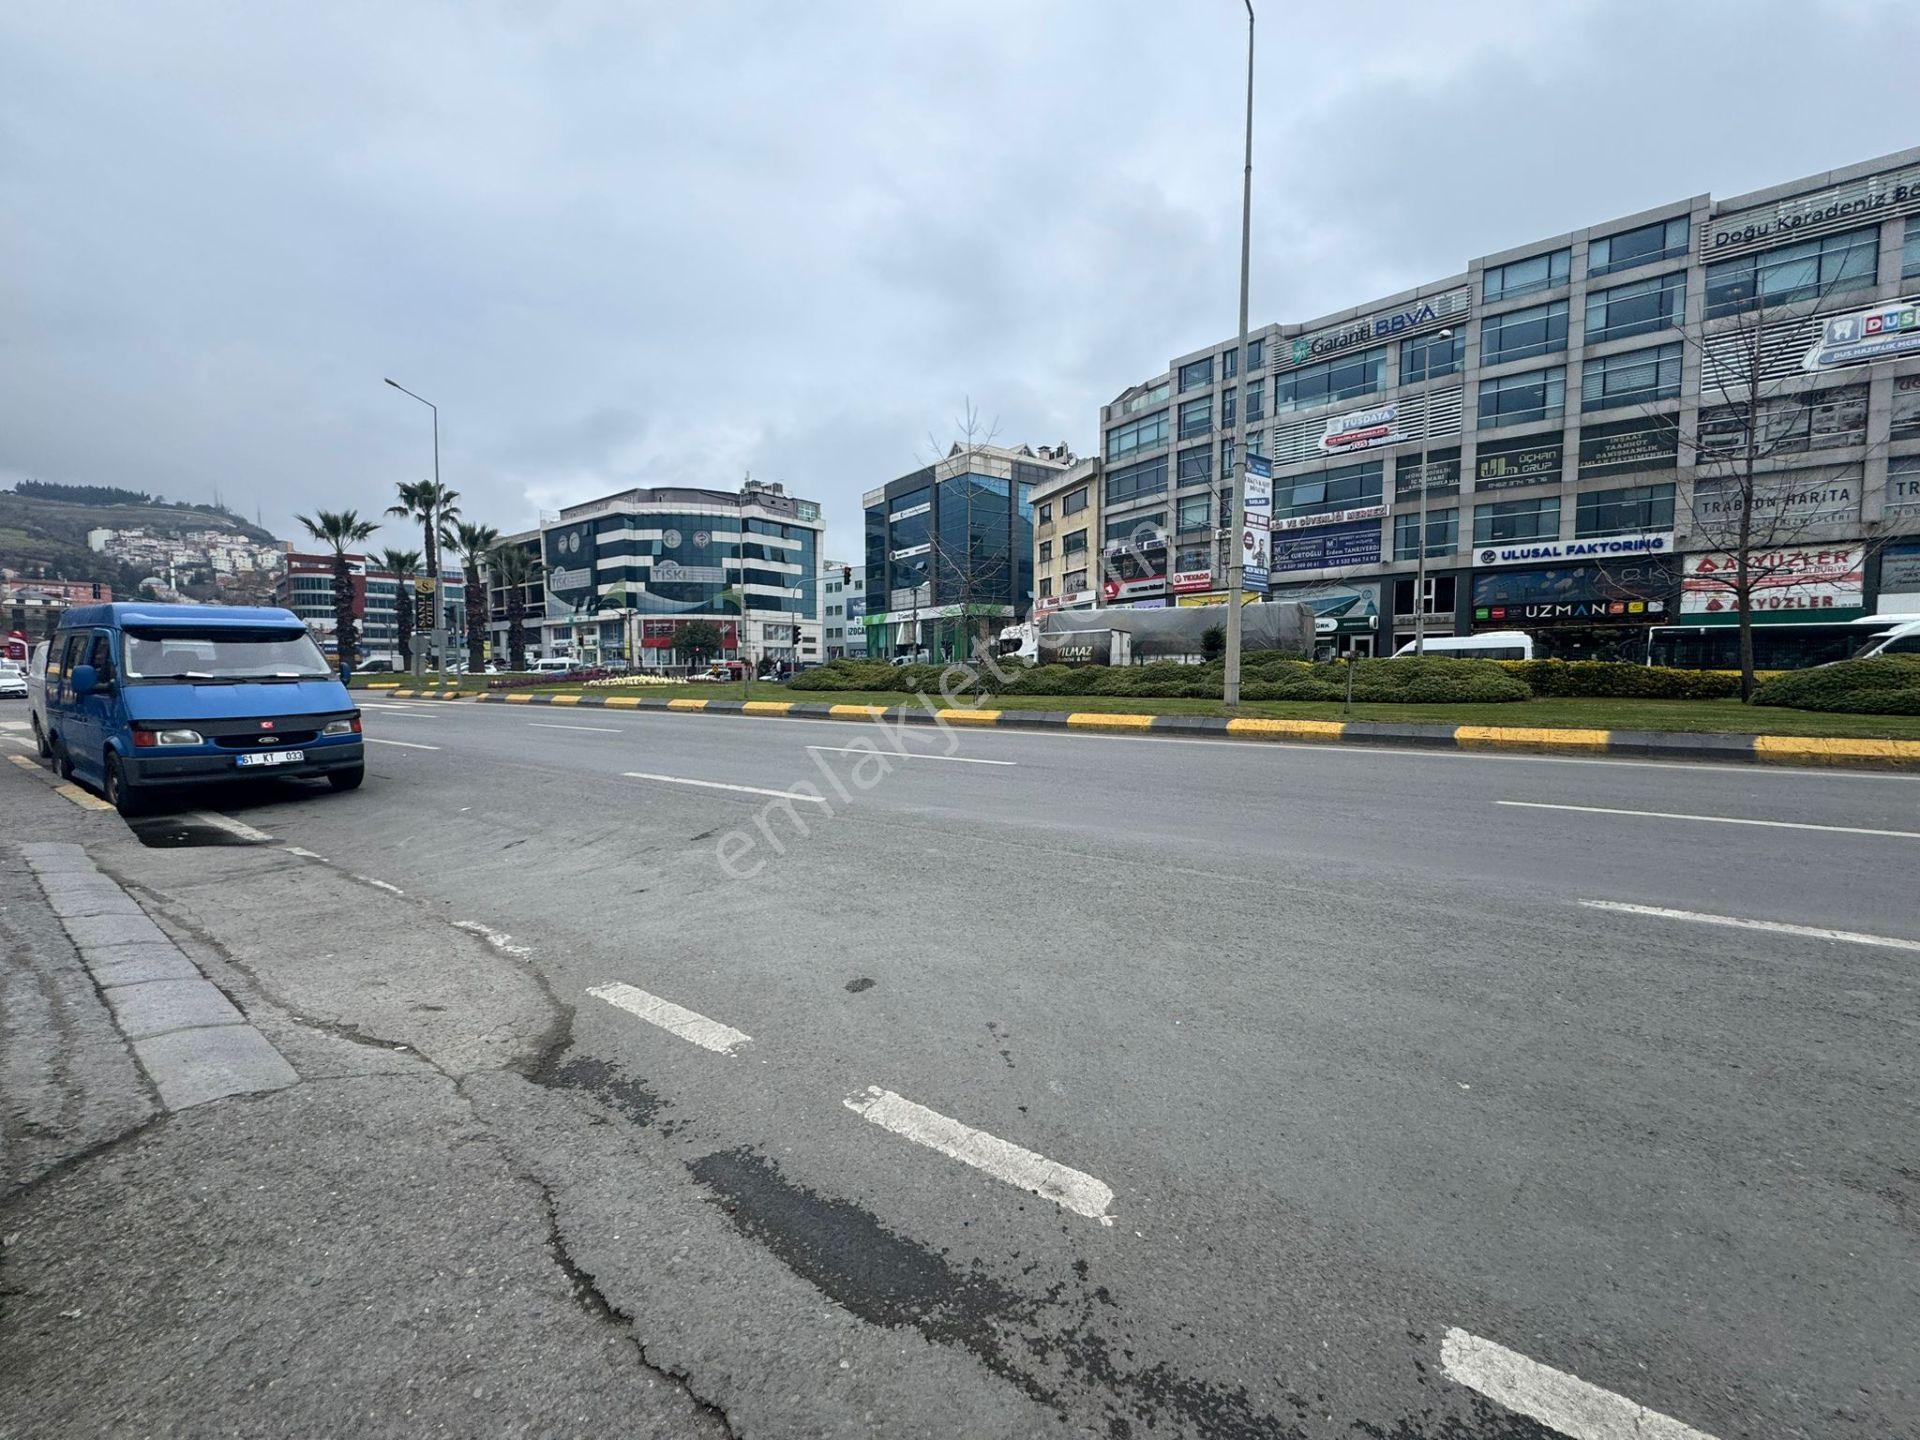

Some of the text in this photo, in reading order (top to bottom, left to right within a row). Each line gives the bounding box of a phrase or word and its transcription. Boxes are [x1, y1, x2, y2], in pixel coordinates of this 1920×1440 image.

[1716, 223, 1769, 247] Doğu
[1777, 193, 1886, 231] Karadeniz
[1867, 308, 1920, 331] DUS
[1311, 304, 1437, 354] Garanti BBVA
[1344, 411, 1390, 428] TUSDATA
[1522, 461, 1553, 472] GRUP
[1702, 487, 1850, 514] TRABON HARİTA
[1501, 546, 1561, 561] ULUSAL
[1525, 603, 1606, 618] UZMAN
[1057, 646, 1093, 657] YILMAZ
[243, 751, 303, 765] 61 KT 033
